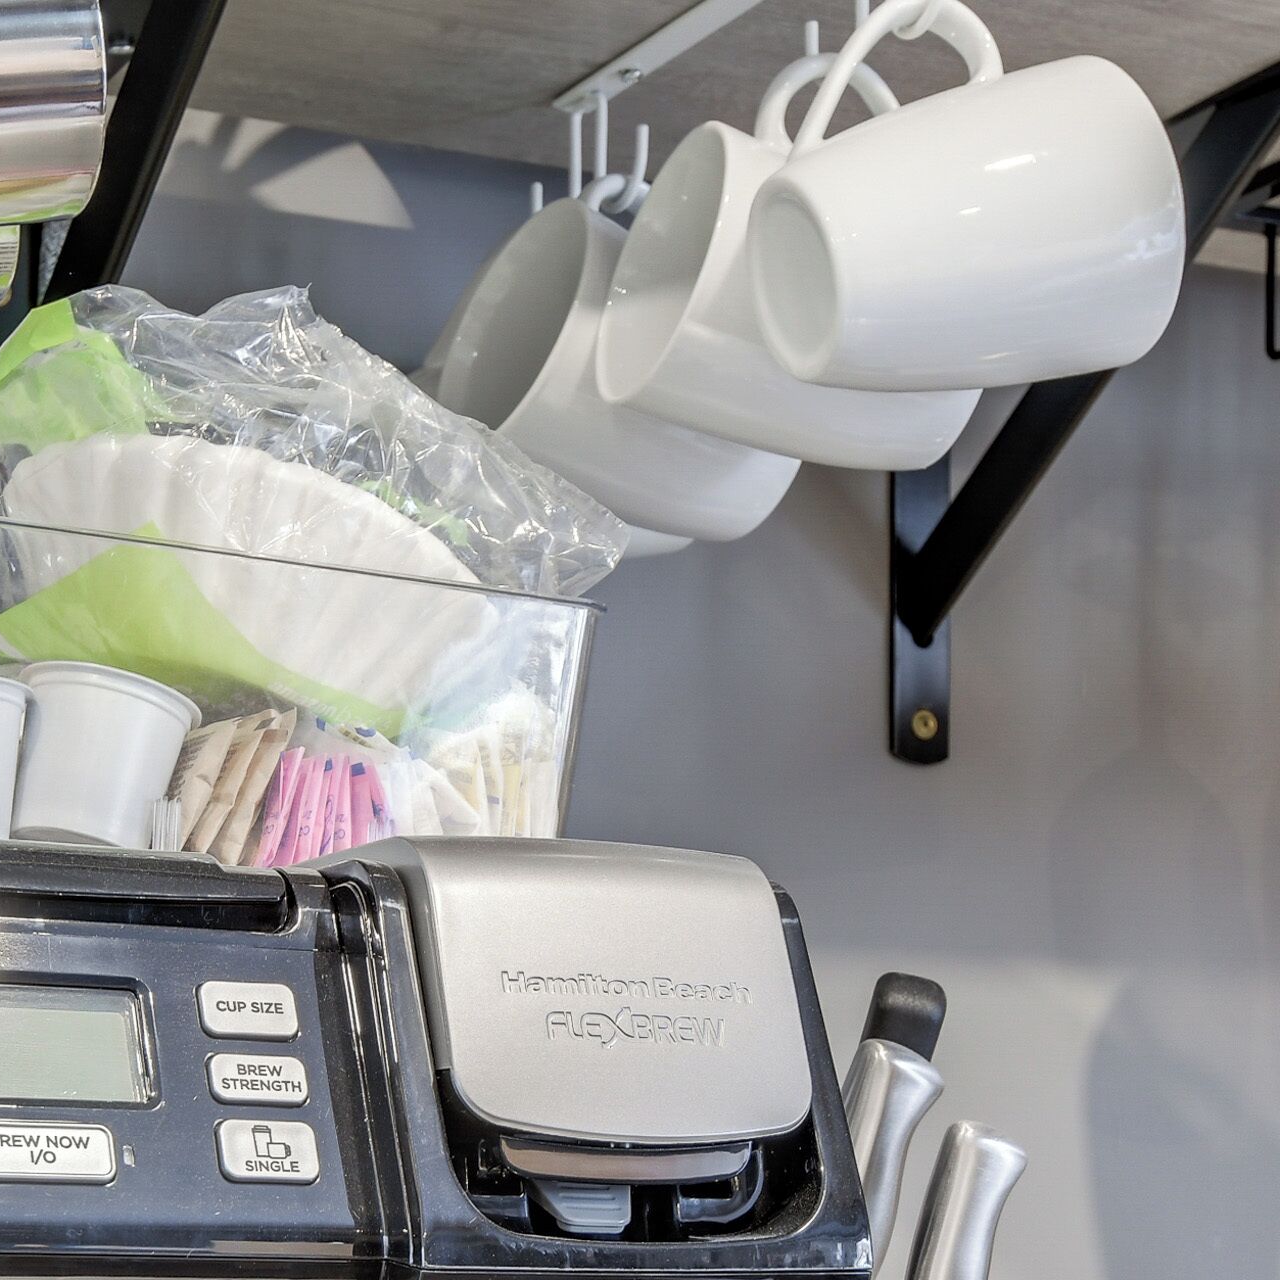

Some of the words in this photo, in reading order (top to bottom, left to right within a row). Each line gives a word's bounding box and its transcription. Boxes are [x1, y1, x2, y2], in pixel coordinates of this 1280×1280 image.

[501, 971, 650, 998] Hamilton
[652, 977, 752, 1005] Beach
[216, 1000, 247, 1013] CUP
[251, 1002, 285, 1014] SIZE
[545, 1006, 725, 1049] FLEXBREW
[236, 1064, 283, 1077] BREW
[222, 1078, 302, 1093] STRENGTH
[46, 1135, 90, 1149] NOW
[30, 1149, 57, 1165] I/O
[245, 1160, 300, 1173] SINGLE
